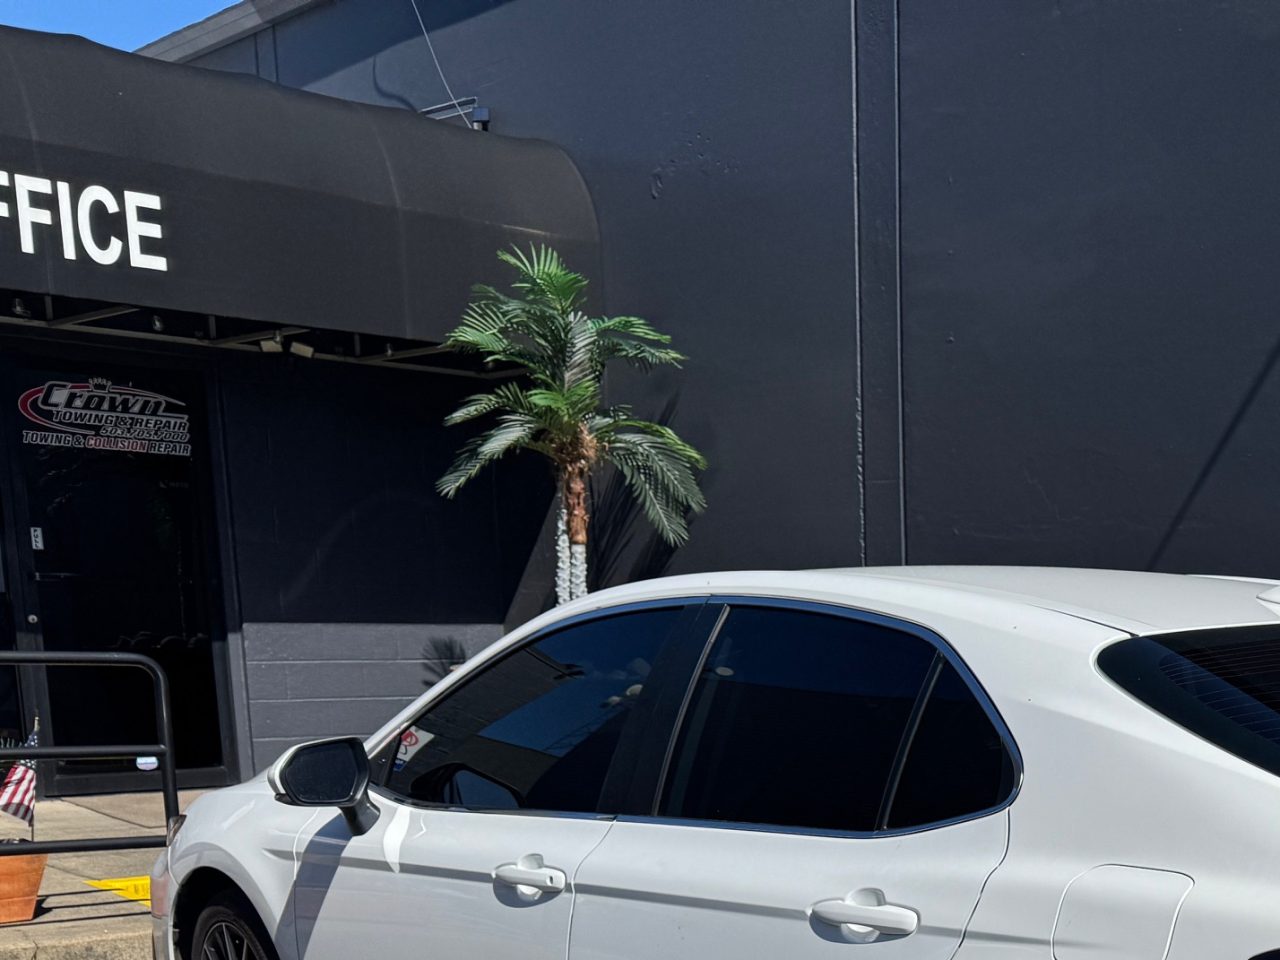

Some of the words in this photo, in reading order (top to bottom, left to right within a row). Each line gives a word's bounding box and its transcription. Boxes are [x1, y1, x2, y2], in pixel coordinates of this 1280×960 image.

[0, 170, 168, 272] FICE
[38, 381, 165, 416] Crown
[53, 409, 116, 427] TOWING
[117, 416, 132, 428] &
[133, 416, 190, 432] REPAIR
[22, 430, 71, 447] TOWING
[73, 435, 84, 448] &
[85, 435, 148, 453] COLLISION
[148, 442, 192, 456] REPAIR
